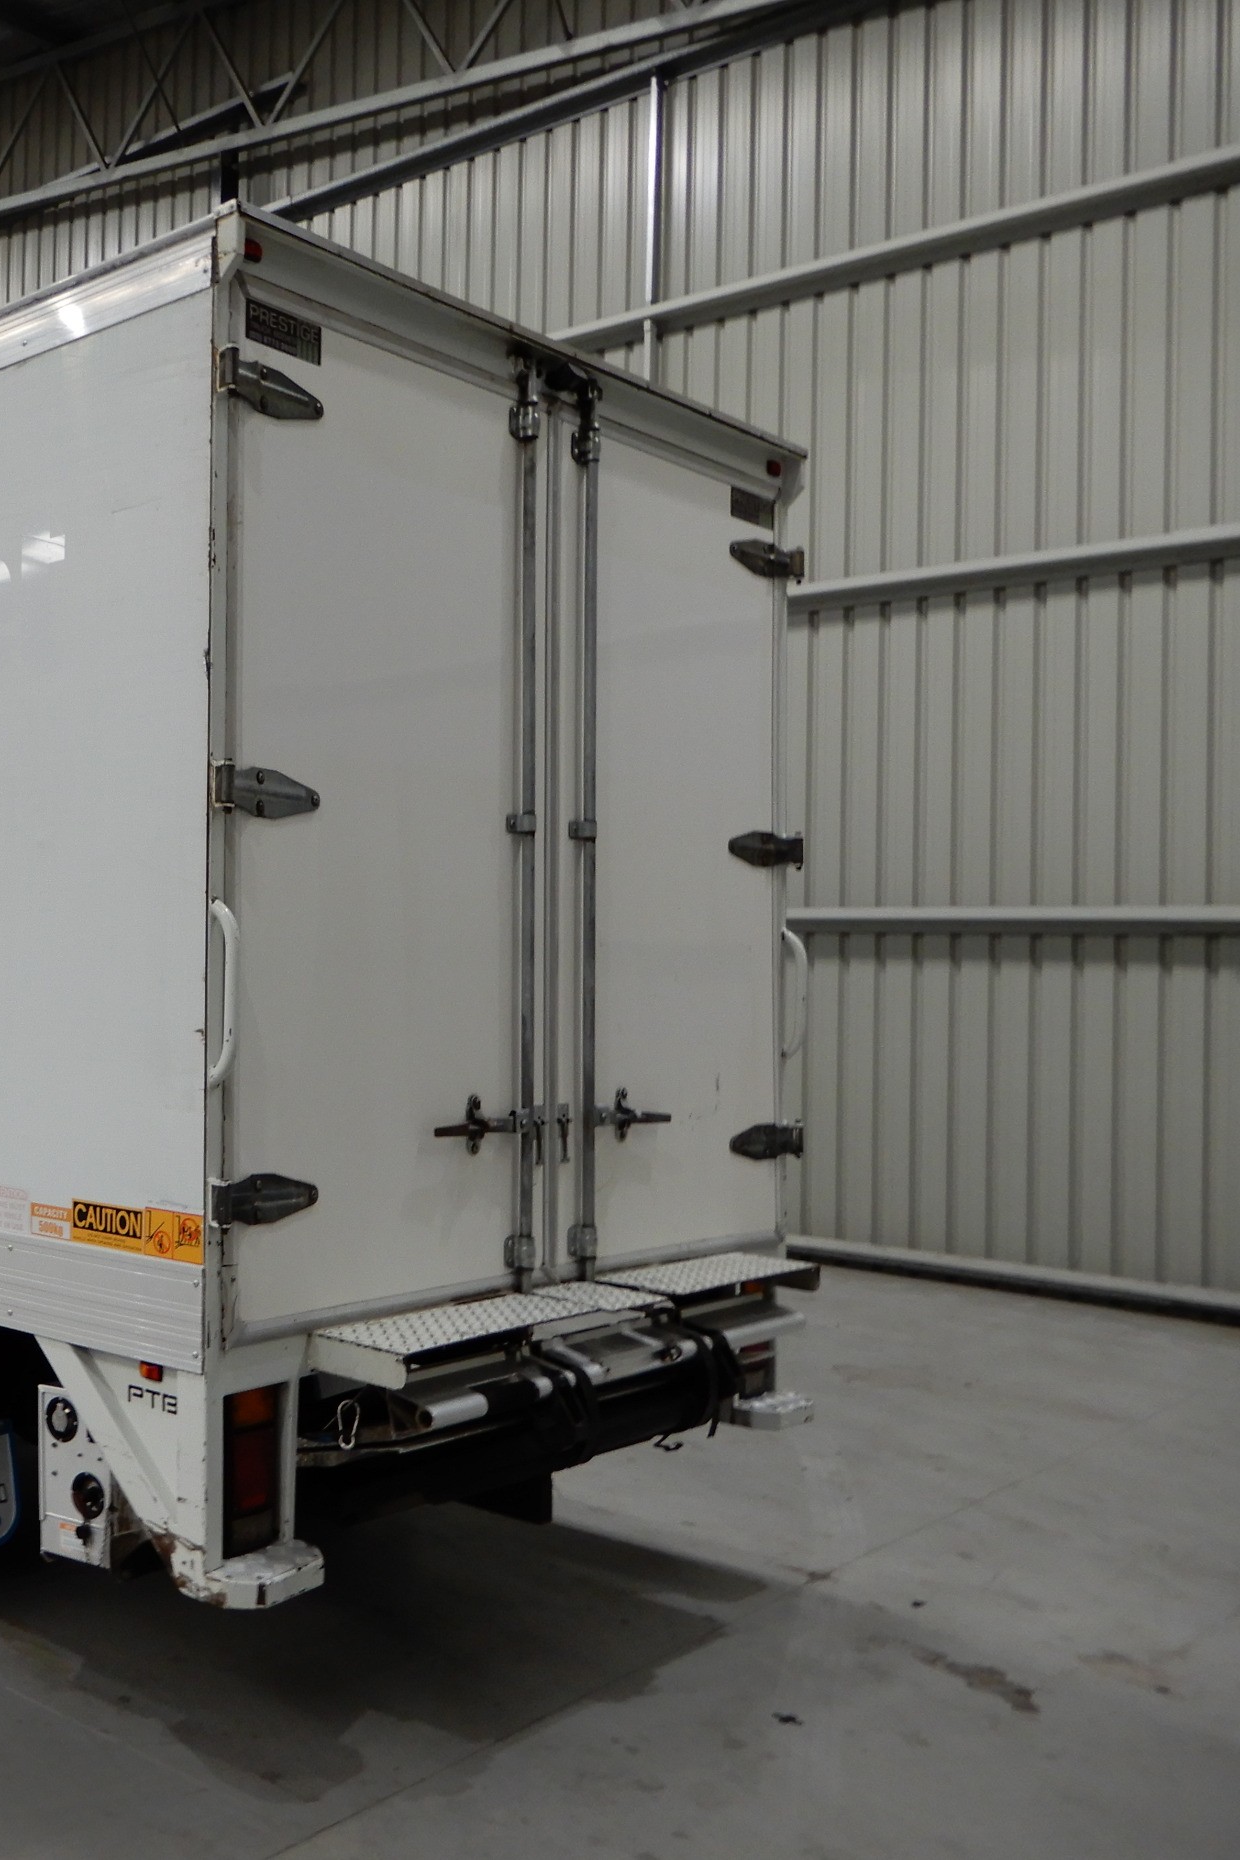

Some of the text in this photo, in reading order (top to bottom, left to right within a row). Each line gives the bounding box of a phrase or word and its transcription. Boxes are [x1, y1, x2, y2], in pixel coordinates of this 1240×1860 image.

[249, 303, 319, 343] PRESTIGE
[33, 1206, 68, 1219] CAPACITY
[74, 1203, 142, 1237] CAUTION
